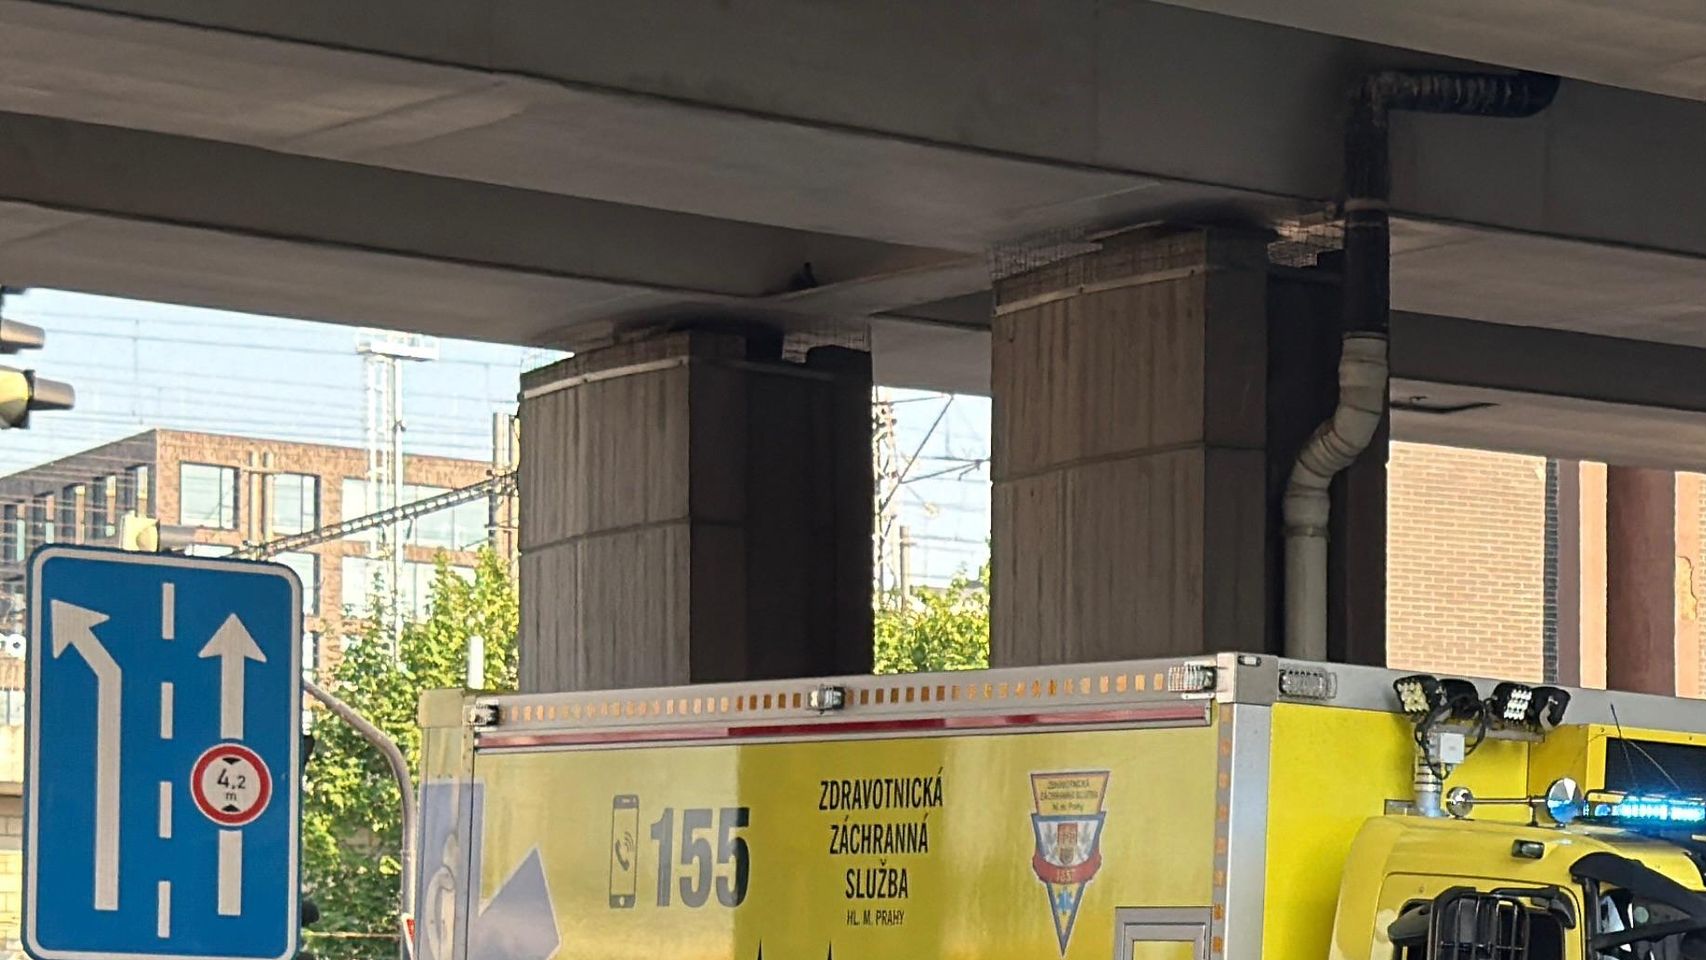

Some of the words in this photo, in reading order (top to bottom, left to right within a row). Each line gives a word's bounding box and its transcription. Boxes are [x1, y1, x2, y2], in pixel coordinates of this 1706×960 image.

[225, 792, 237, 801] m
[819, 767, 944, 810] ZDRAVOTNICKÁ
[830, 813, 929, 854] ZÁCHRANNÁ
[651, 807, 750, 908] 155
[845, 859, 908, 898] SLUŽBA
[876, 910, 904, 925] PRAHY
